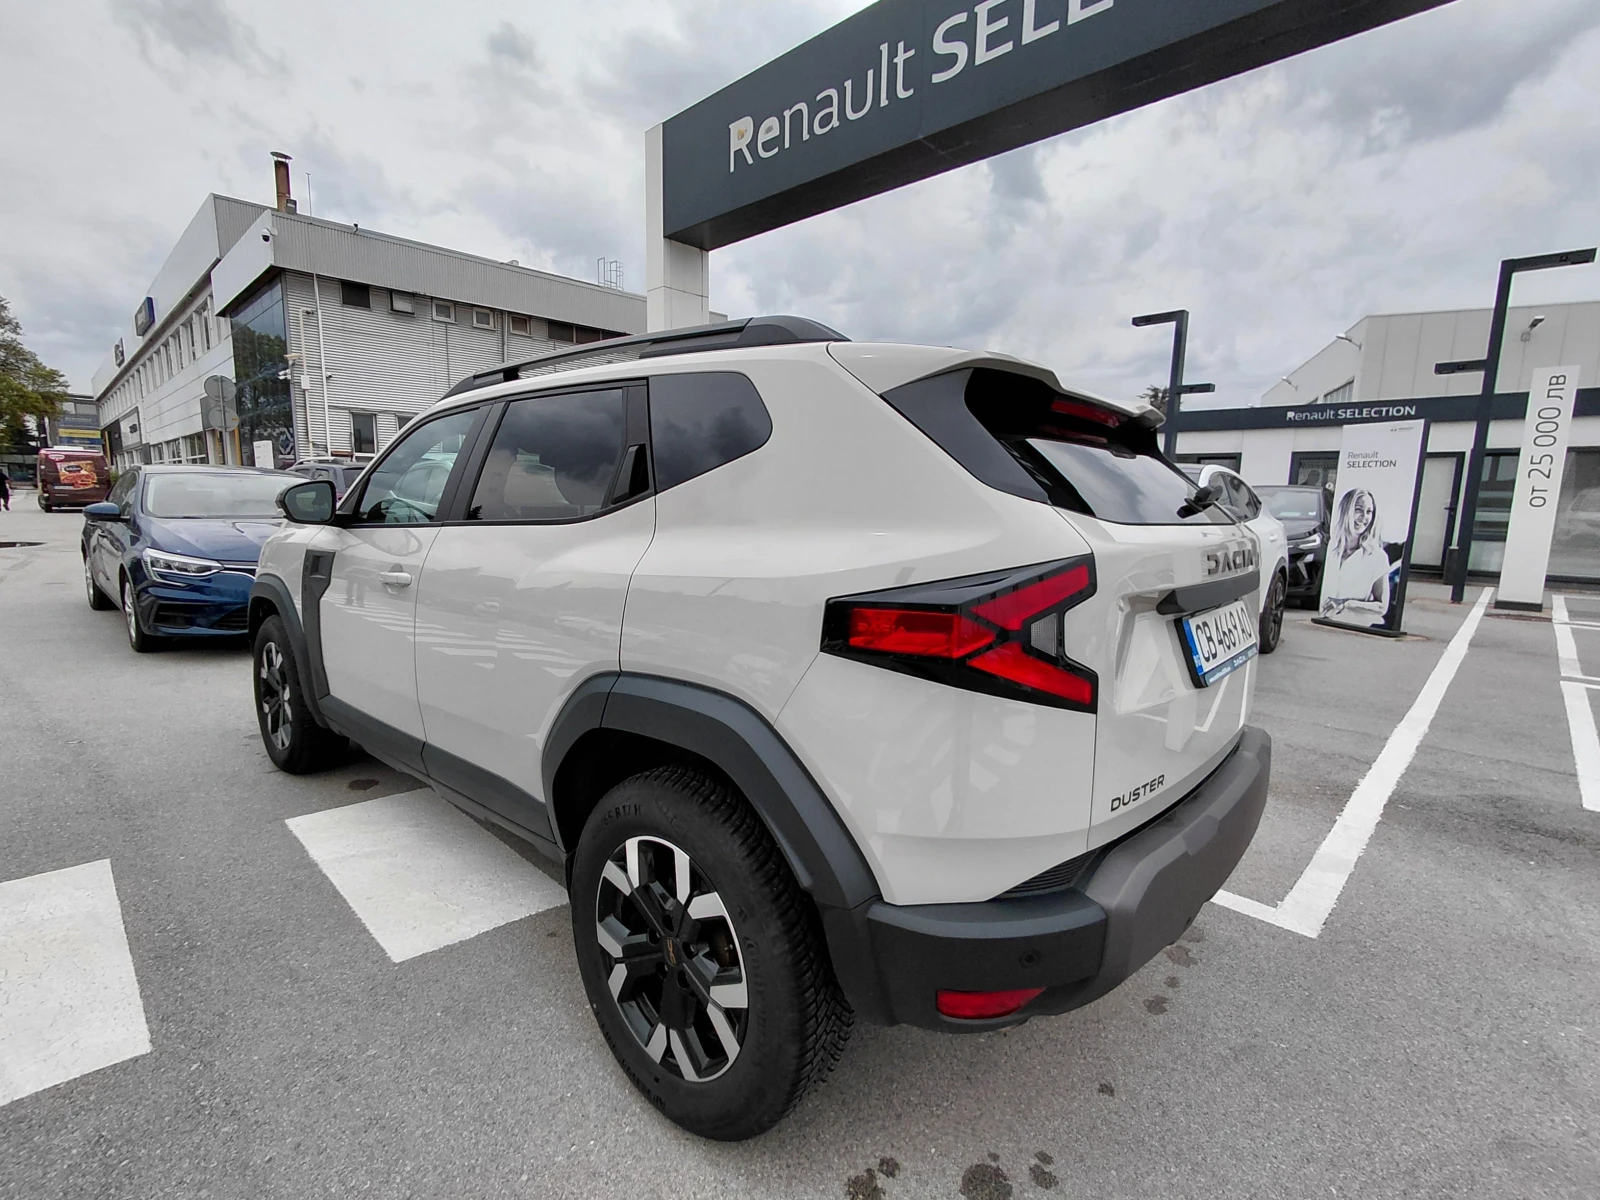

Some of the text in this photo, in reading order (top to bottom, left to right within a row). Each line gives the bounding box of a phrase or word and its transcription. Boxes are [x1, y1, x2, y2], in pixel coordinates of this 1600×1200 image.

[728, 40, 916, 173] Renault
[1286, 405, 1417, 421] Renault SELECTION
[1532, 406, 1562, 448] 000
[1346, 459, 1397, 469] SELECTION
[1347, 451, 1379, 460] Renault
[1527, 454, 1555, 479] 25
[1214, 610, 1241, 654] 4669
[1110, 774, 1165, 812] DUSTER
